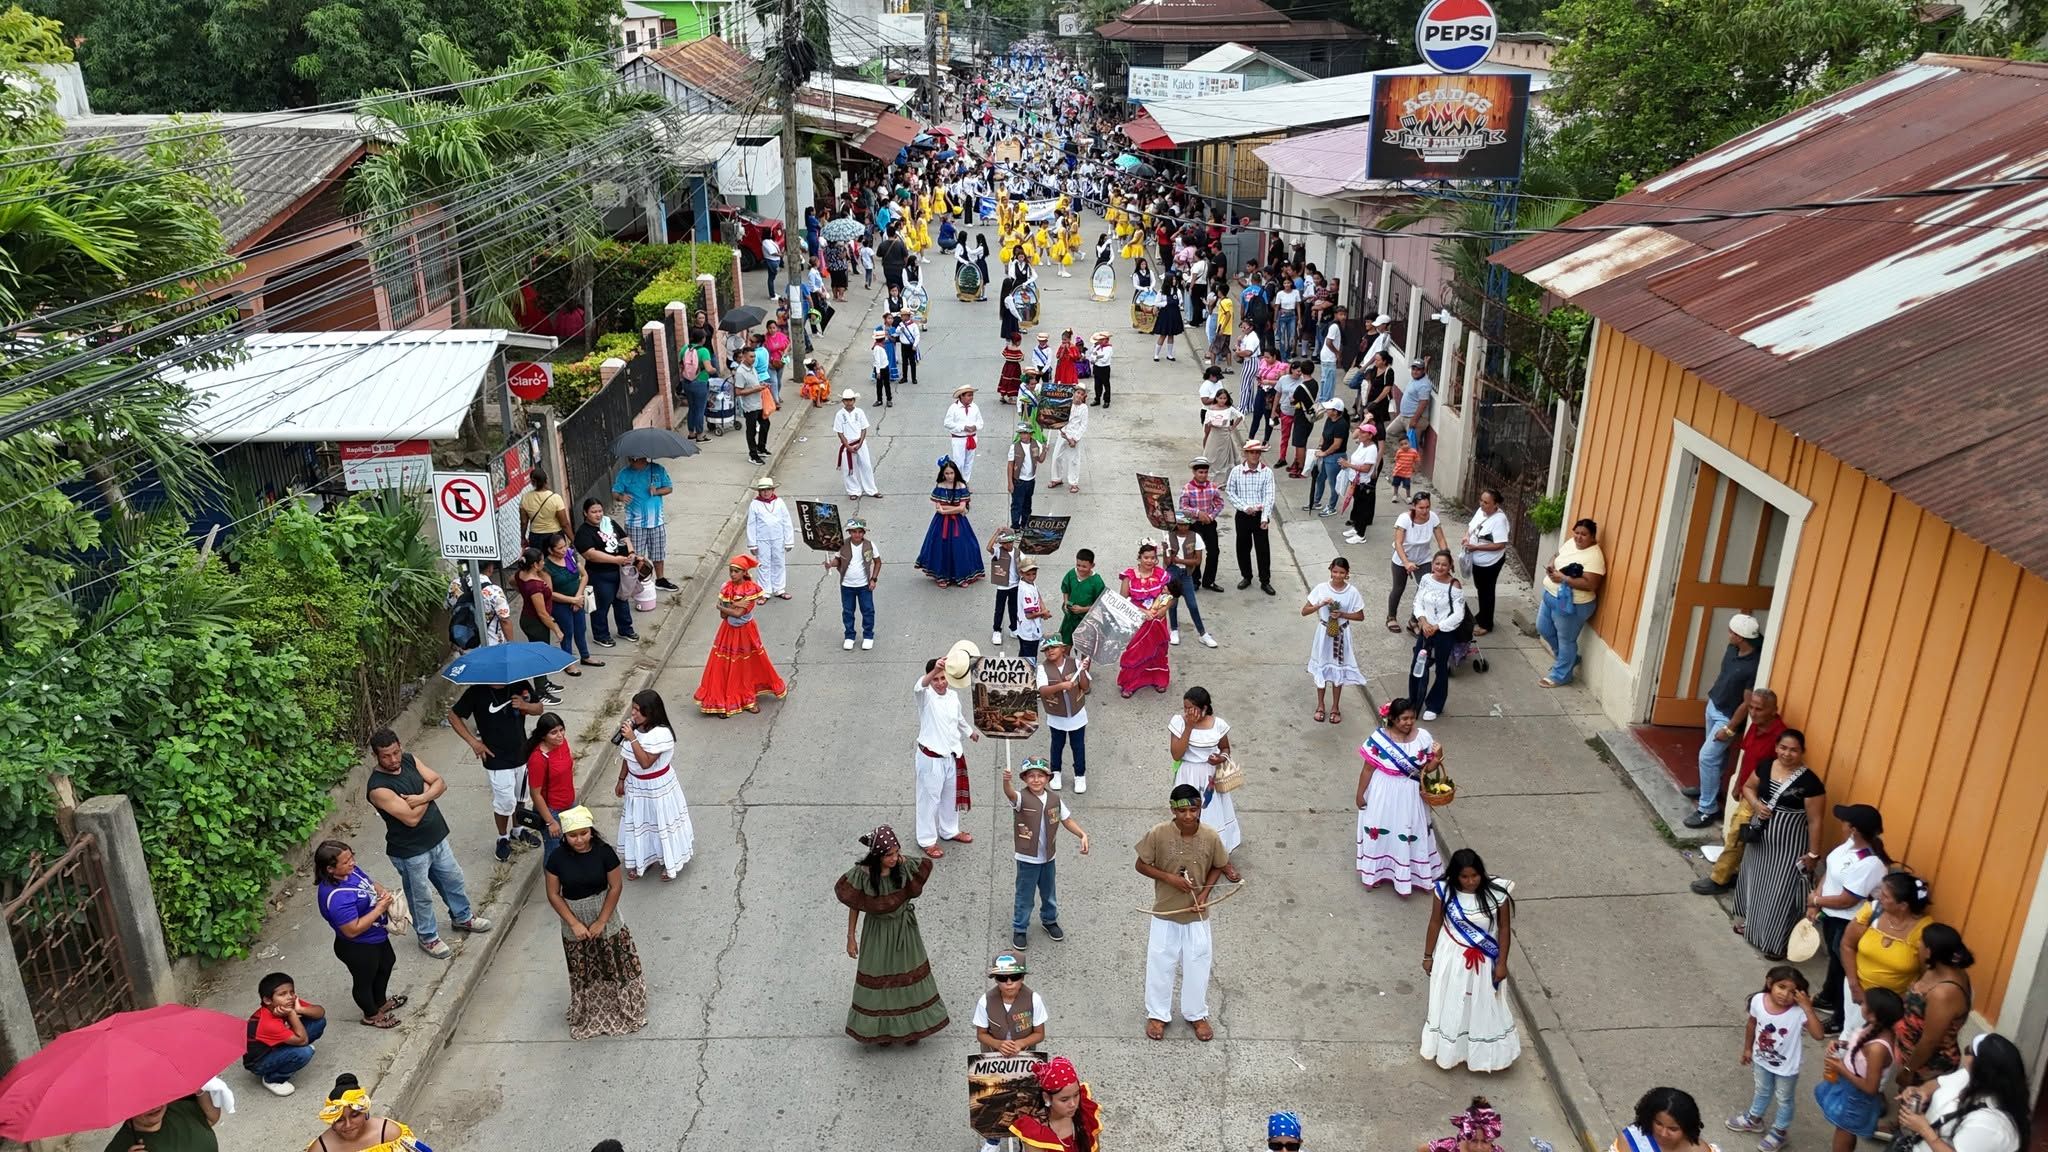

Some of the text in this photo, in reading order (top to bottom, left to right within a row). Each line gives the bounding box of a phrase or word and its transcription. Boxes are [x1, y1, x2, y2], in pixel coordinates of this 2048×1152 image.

[1425, 25, 1492, 41] PEPSI
[1403, 88, 1493, 114] ASADOS
[1406, 136, 1483, 148] LOS PRIMOS
[511, 376, 541, 386] Claro
[801, 504, 814, 540] PECH
[1029, 520, 1067, 529] CREOLES
[459, 530, 478, 542] NO
[445, 544, 495, 554] ESTACIONAR
[1105, 594, 1141, 622] TOLUPANES
[984, 658, 1025, 671] MAYA
[980, 670, 1029, 684] CHORTI
[974, 1059, 1043, 1075] MISQUITO
